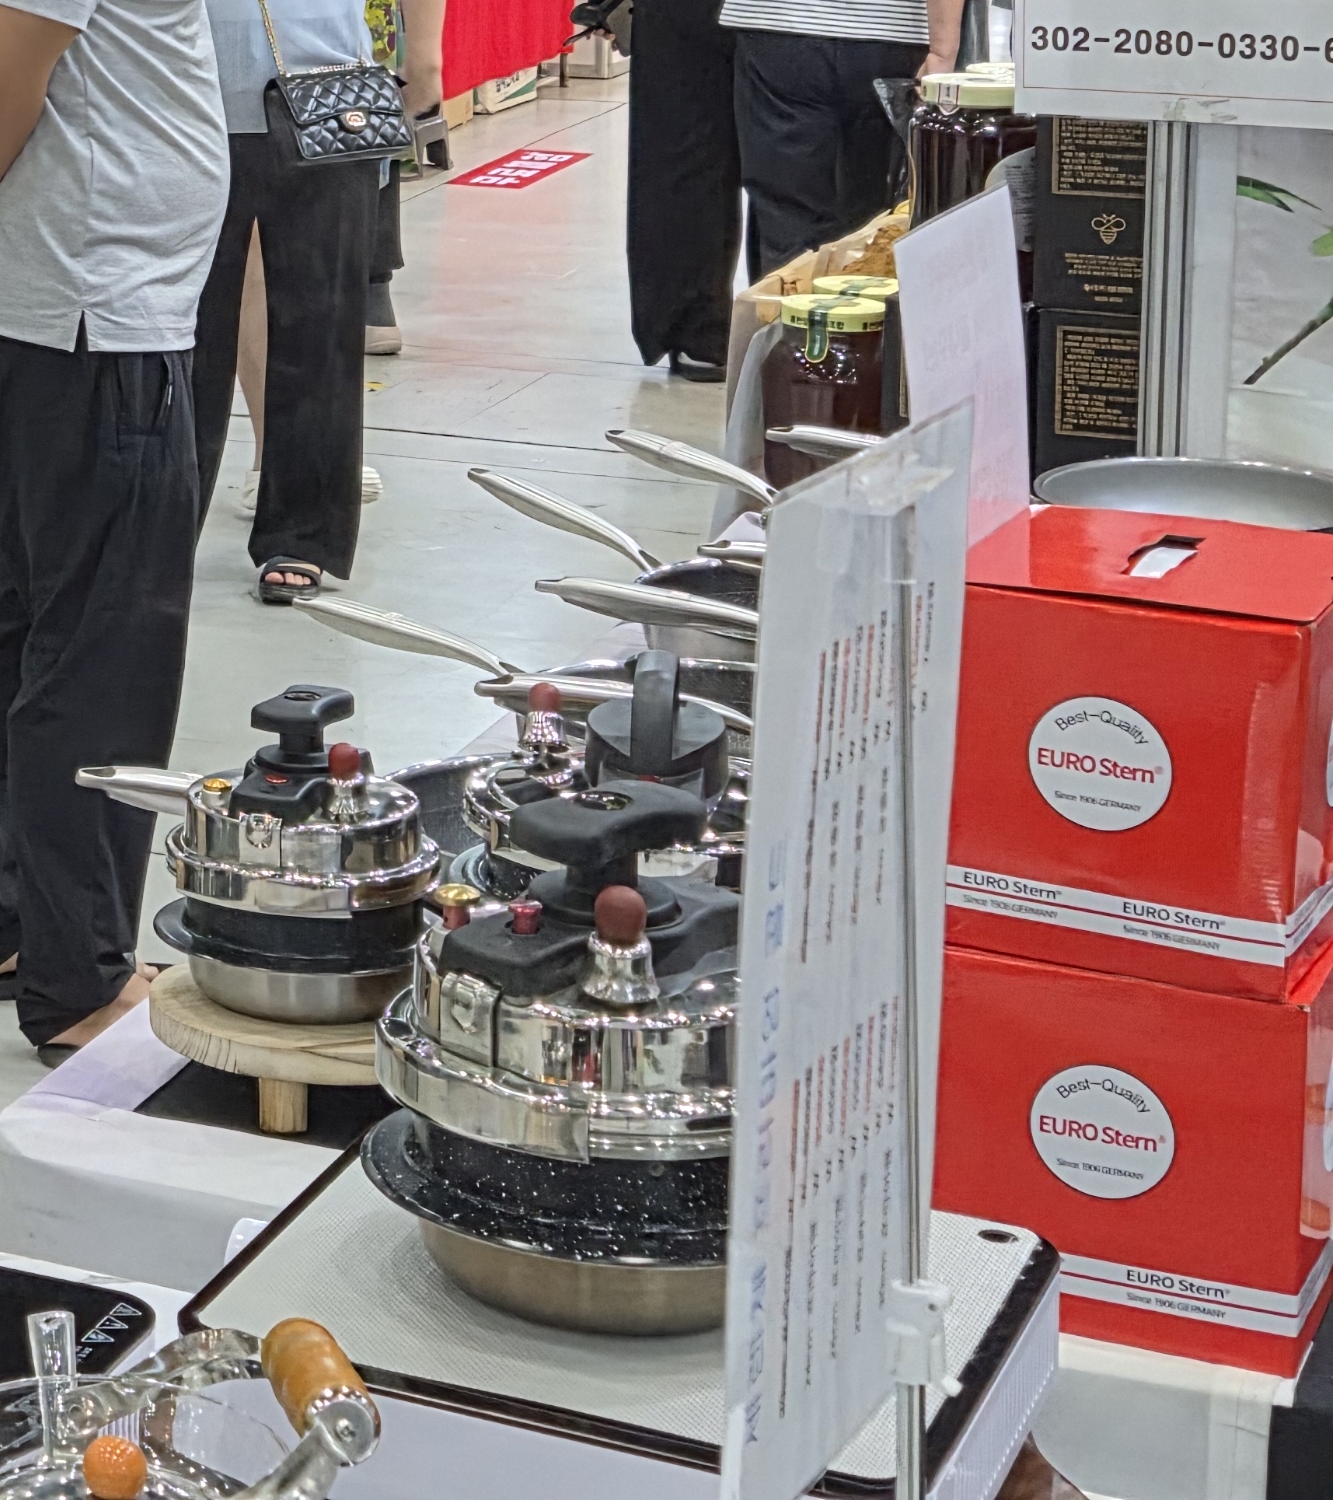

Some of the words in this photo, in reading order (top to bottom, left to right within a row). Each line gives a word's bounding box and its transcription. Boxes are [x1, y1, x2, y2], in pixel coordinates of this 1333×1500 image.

[1037, 747, 1096, 773] EURO
[963, 871, 1009, 891] EURO
[1123, 902, 1170, 921] EURO
[1039, 1114, 1098, 1141] EURO
[1126, 1268, 1175, 1289] EURO
